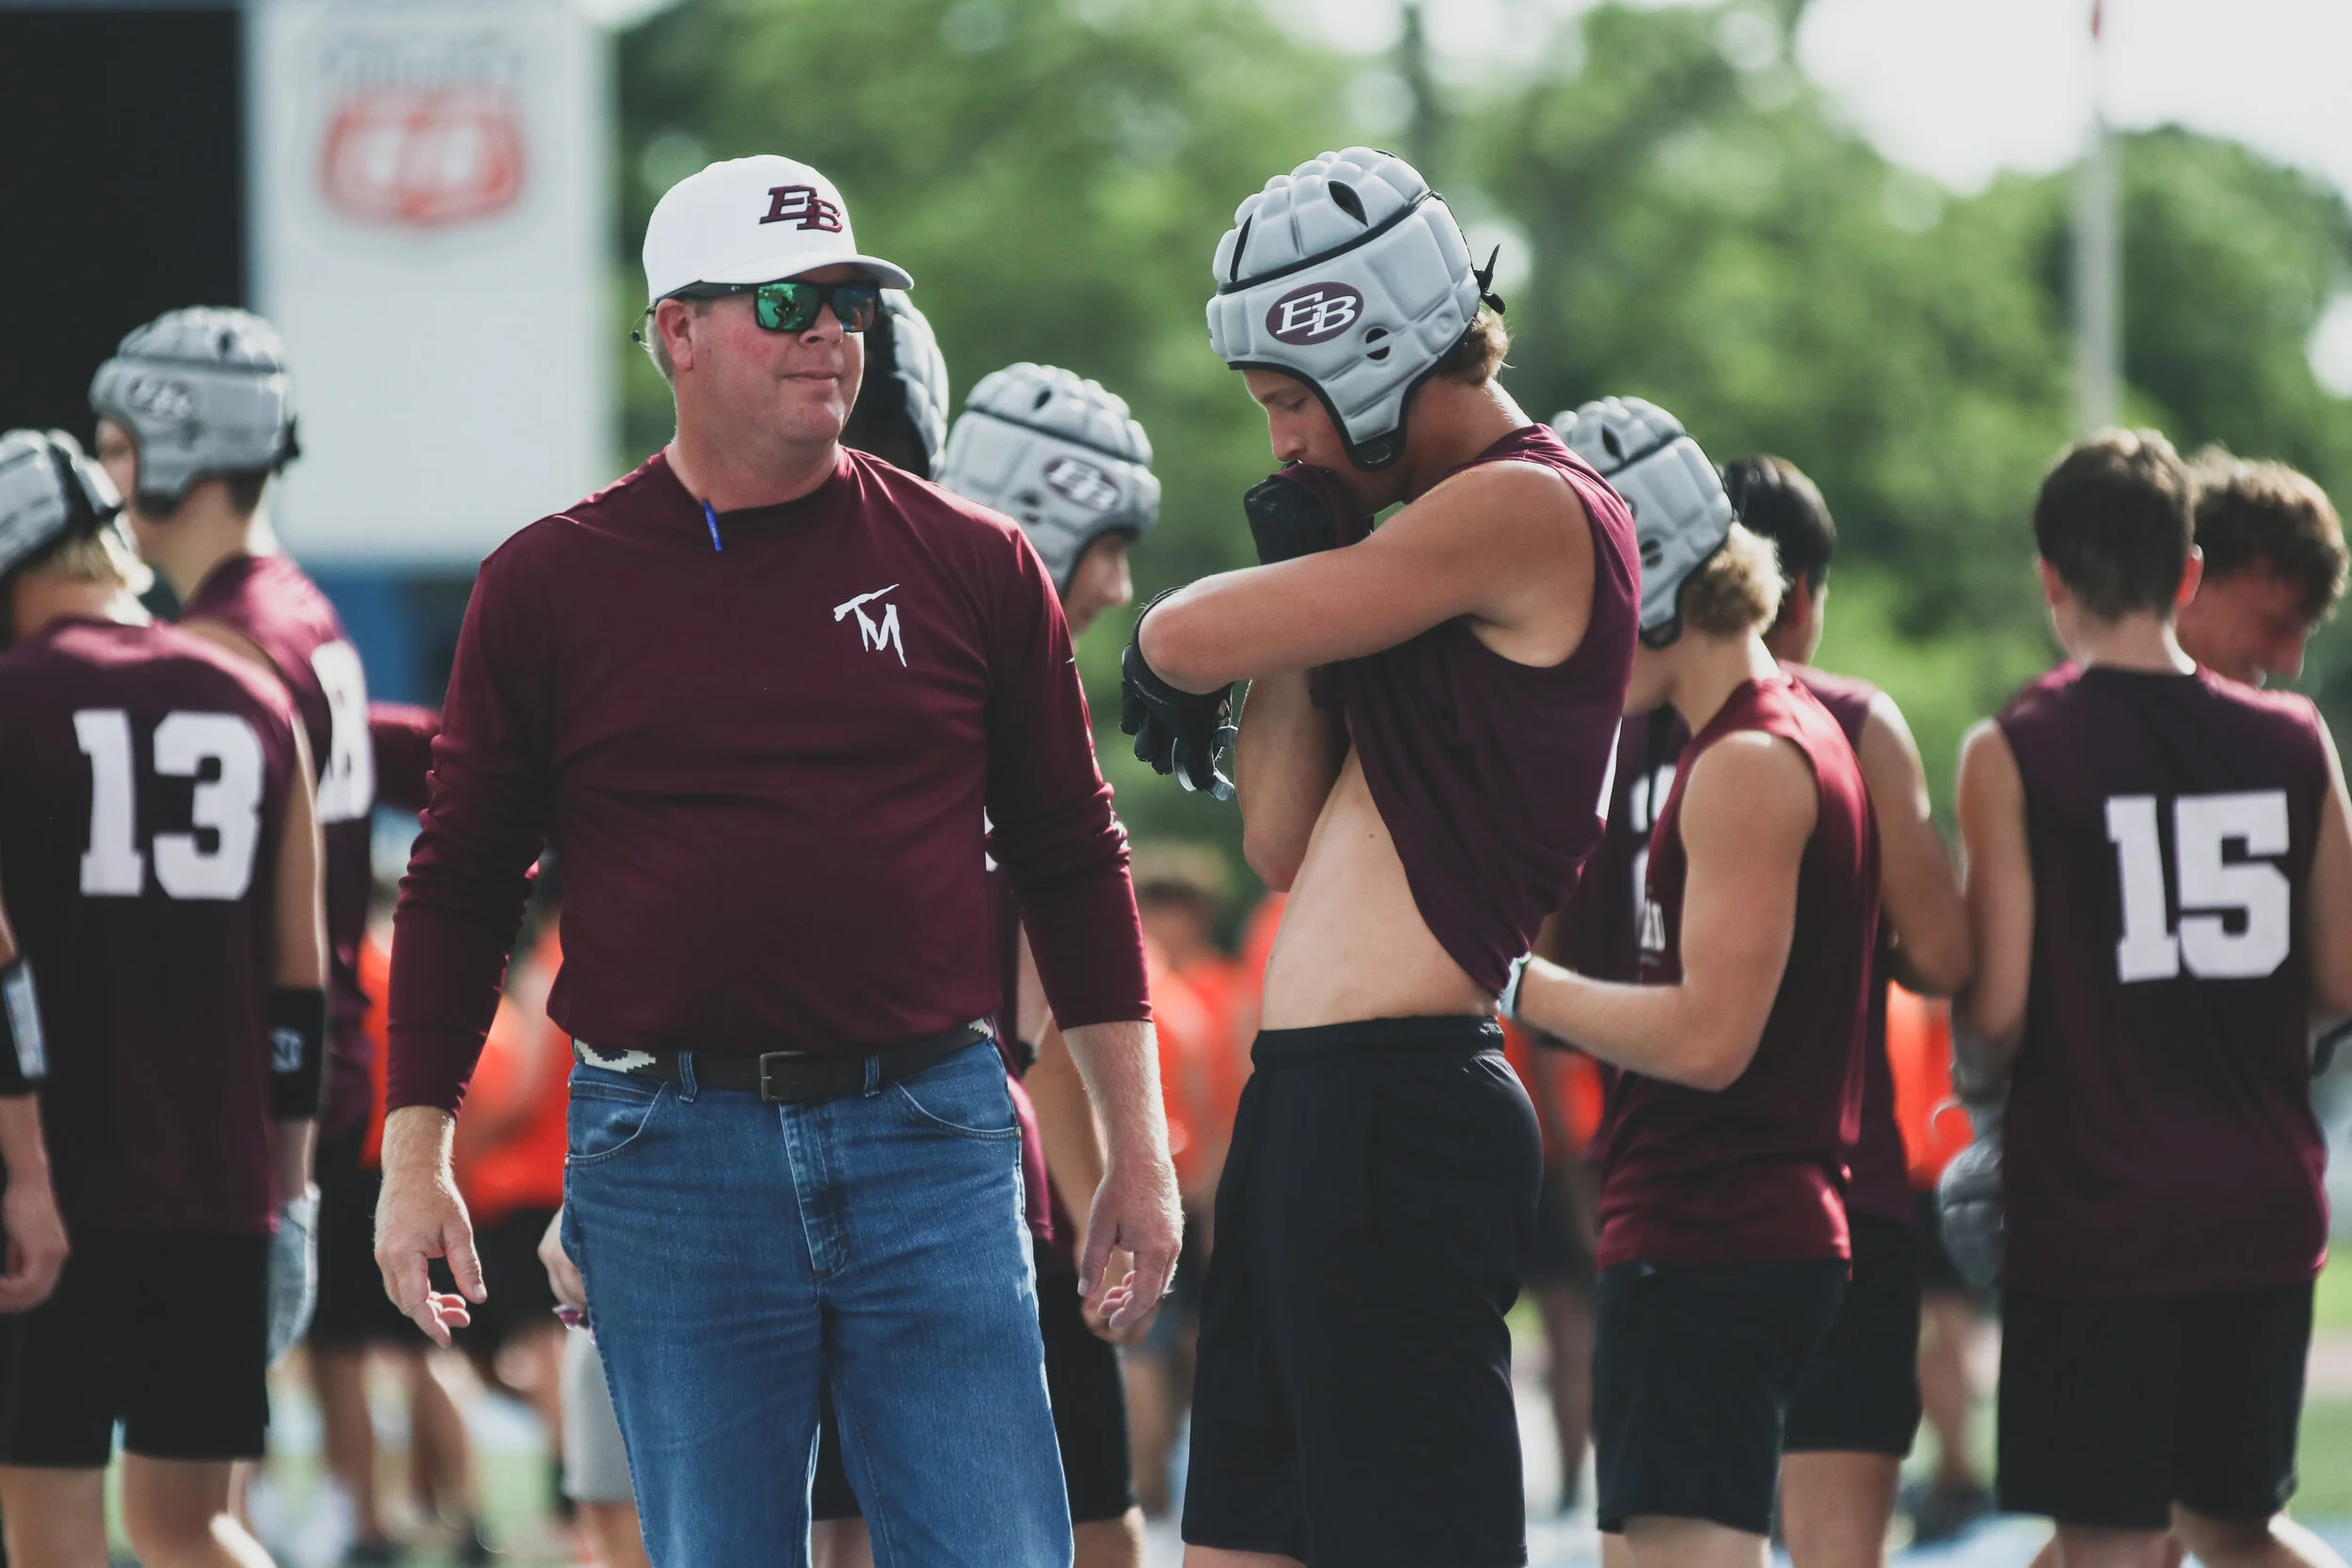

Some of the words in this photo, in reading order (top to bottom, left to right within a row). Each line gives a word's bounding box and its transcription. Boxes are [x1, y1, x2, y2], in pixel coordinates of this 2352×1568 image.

[759, 184, 843, 233] EB
[1276, 291, 1357, 337] EB
[834, 583, 907, 668] TM
[72, 709, 265, 901] 13
[2104, 788, 2291, 983] 15
